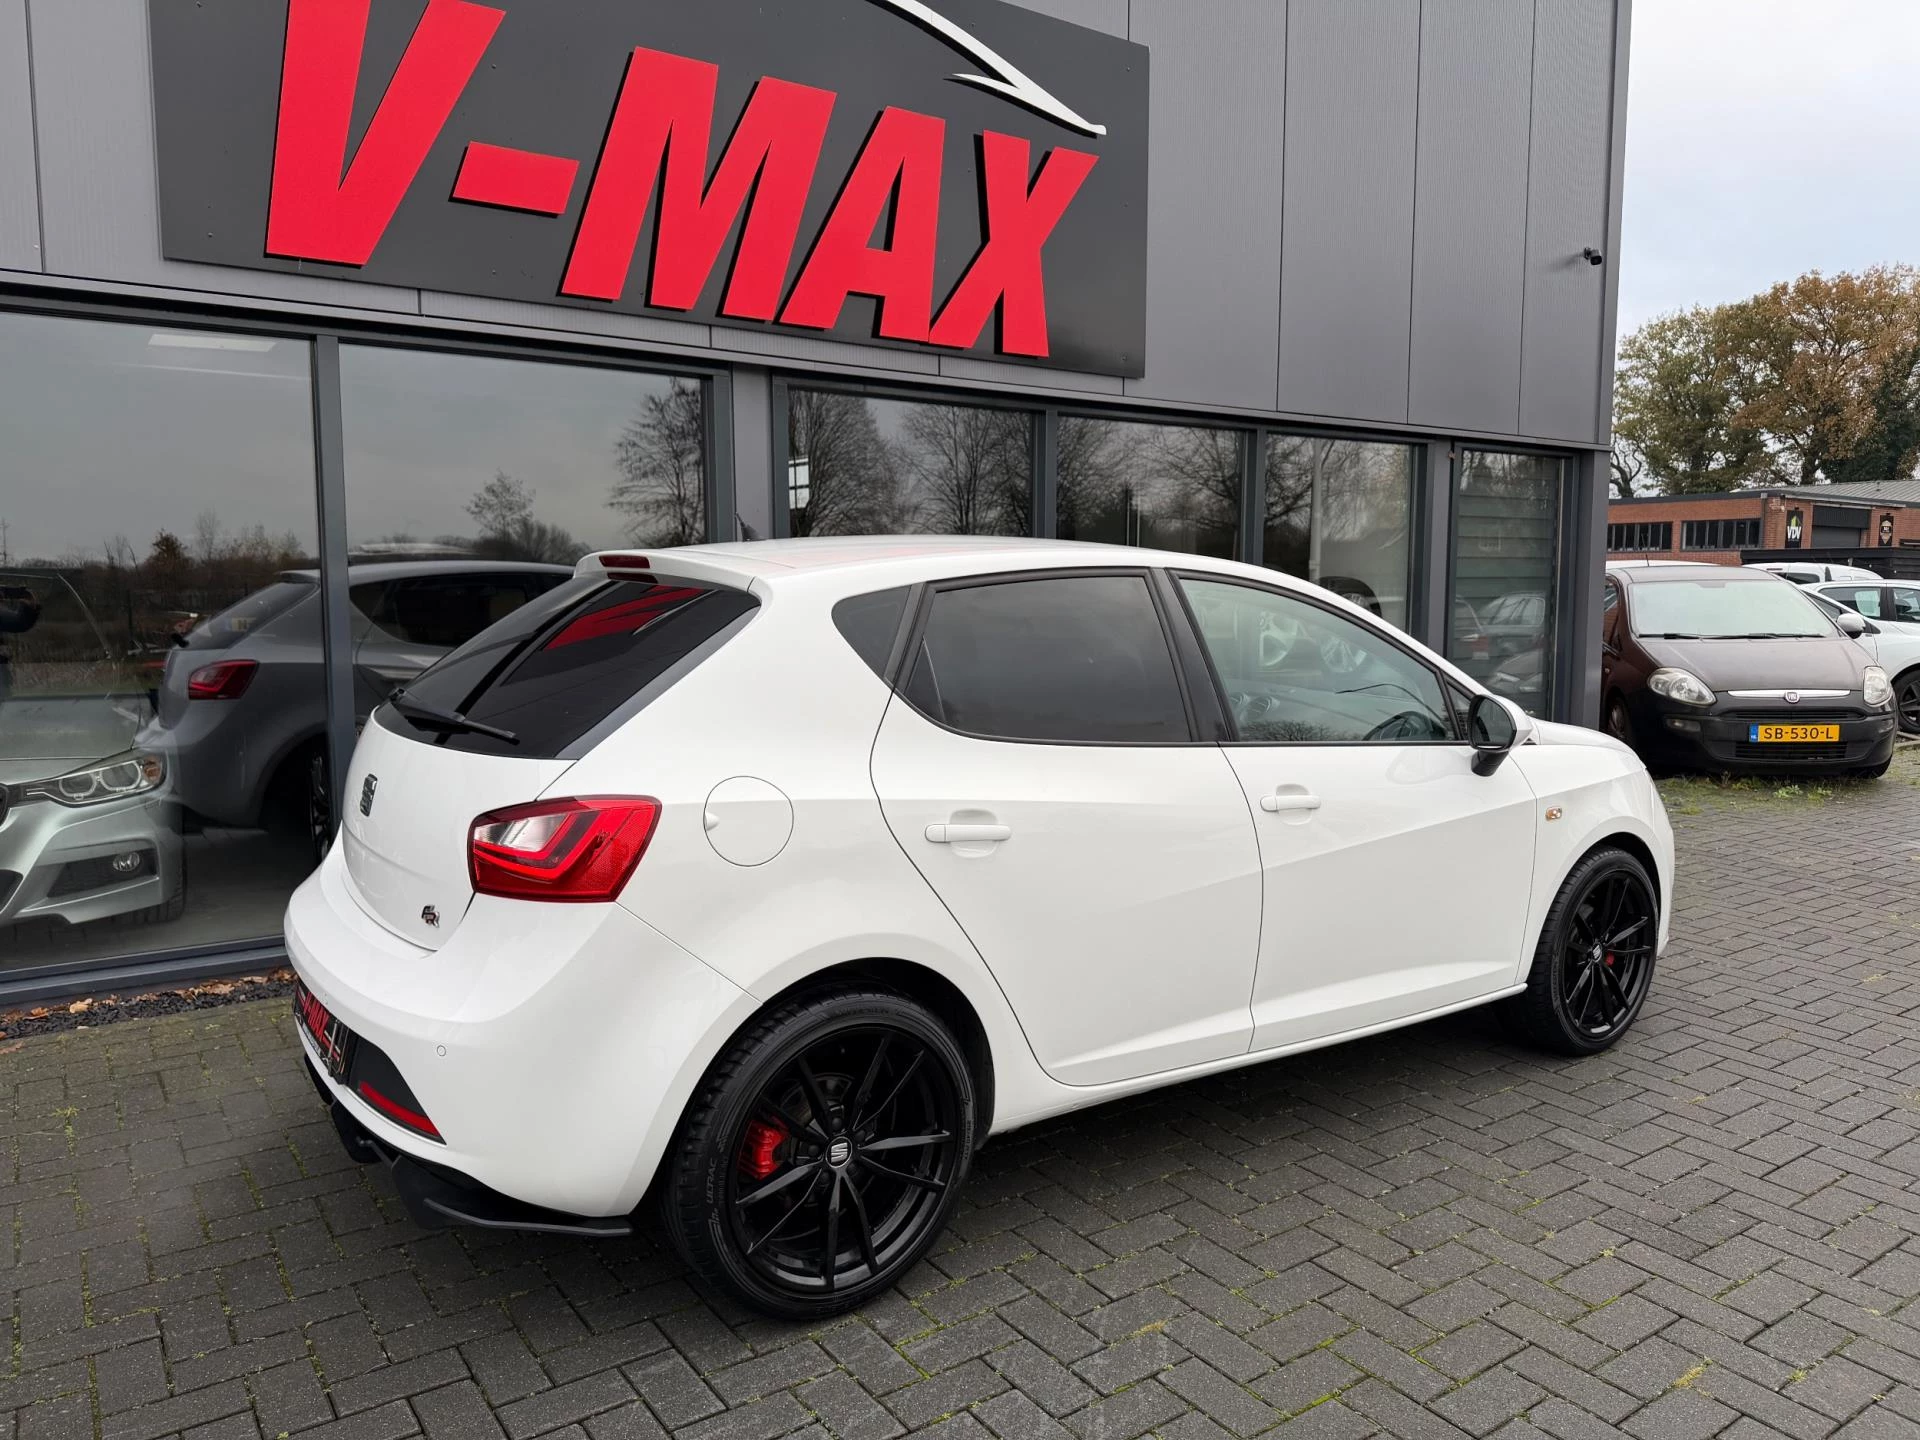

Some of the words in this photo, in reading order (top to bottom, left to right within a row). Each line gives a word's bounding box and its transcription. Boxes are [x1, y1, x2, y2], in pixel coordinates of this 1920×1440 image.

[266, 0, 1098, 357] V-MAX
[1787, 525, 1802, 540] VDV
[1763, 727, 1834, 740] SB-530-L
